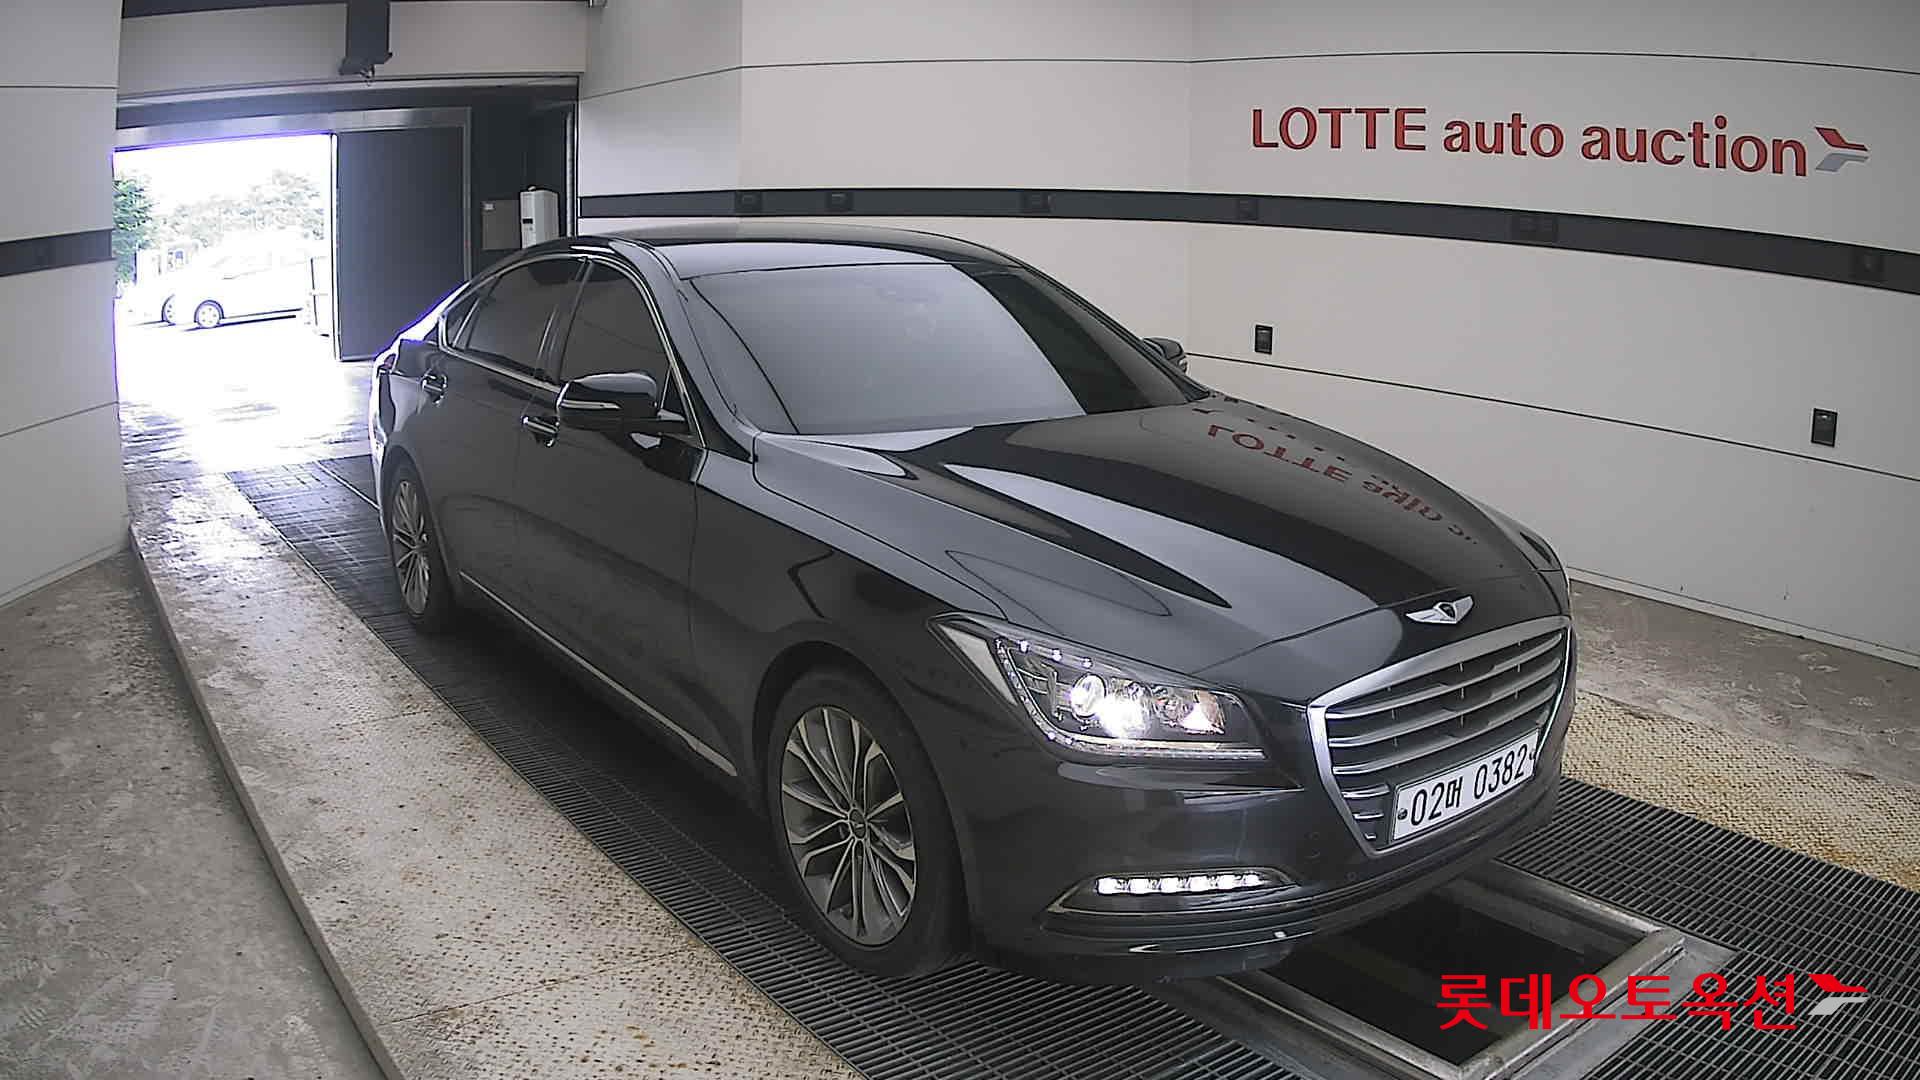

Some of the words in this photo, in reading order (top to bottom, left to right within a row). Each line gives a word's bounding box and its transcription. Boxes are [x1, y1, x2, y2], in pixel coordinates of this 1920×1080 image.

[1252, 106, 1427, 151] LOTTE
[1443, 113, 1565, 158] auto
[1581, 114, 1808, 177] auction
[1410, 776, 1464, 826] 02머
[1473, 744, 1528, 800] 0382
